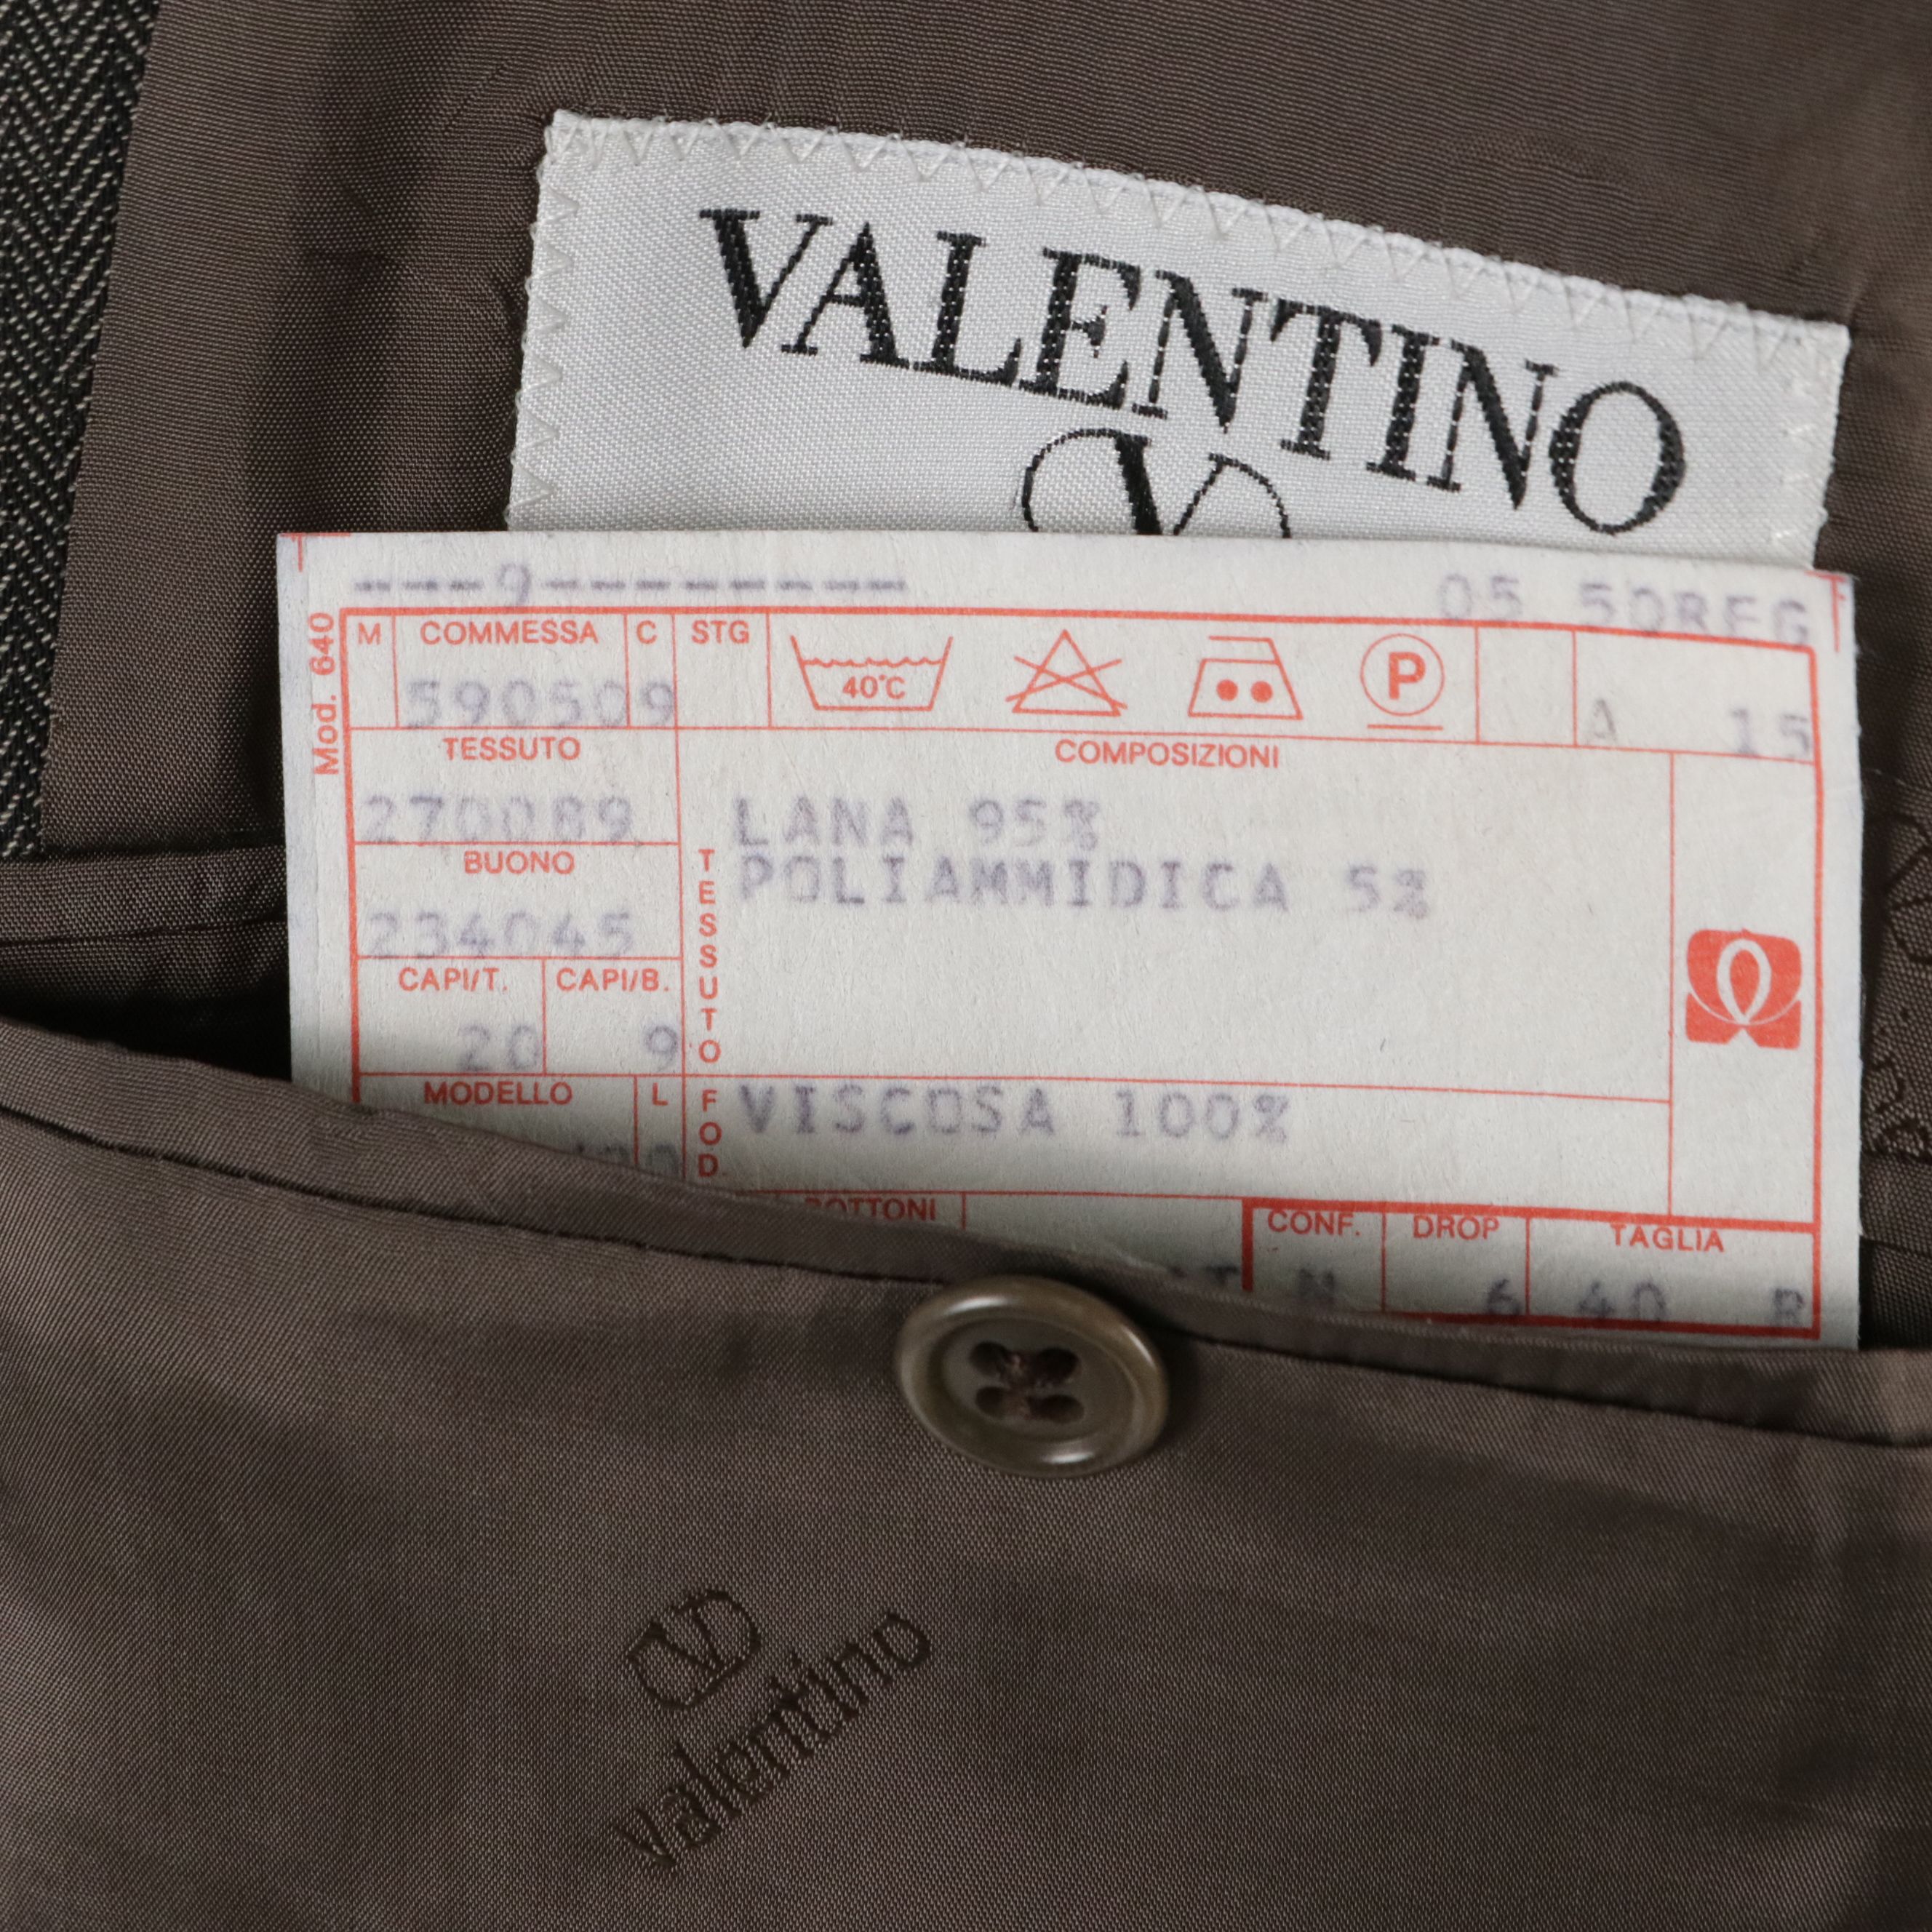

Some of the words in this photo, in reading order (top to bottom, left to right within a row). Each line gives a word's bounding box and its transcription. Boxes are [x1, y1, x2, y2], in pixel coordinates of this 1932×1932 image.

[700, 208, 1686, 536] VALENTINO
[307, 612, 336, 676] 640
[357, 623, 382, 644] M
[419, 620, 599, 644] COMMESSA
[636, 620, 658, 644] C
[690, 619, 751, 644] STG
[1388, 651, 1426, 700] P
[311, 694, 340, 775] Mod.
[1730, 706, 1811, 759] 15
[443, 736, 581, 762] TESSUTO
[1055, 738, 1281, 770] COMPOSIZIONI
[733, 796, 914, 847] LANA
[968, 797, 1101, 853] 95%
[463, 850, 576, 875] BUONO
[738, 854, 1290, 914] POLIAMMIDICA
[1346, 864, 1432, 921] 5%
[369, 910, 636, 959] 234045
[397, 967, 508, 992] CAPI/T.
[554, 967, 670, 992] CAPI/B.
[458, 1023, 540, 1073] 20
[644, 1023, 678, 1073] 9
[424, 1081, 573, 1106] MODELLO
[651, 1082, 668, 1106] L
[738, 1083, 1058, 1136] VISCOSA
[1115, 1090, 1290, 1143] 100%
[1267, 1210, 1360, 1237] CONF.
[1413, 1213, 1501, 1241] DROP
[1610, 1224, 1725, 1253] TAGLIA
[614, 1610, 932, 1868] valentino
